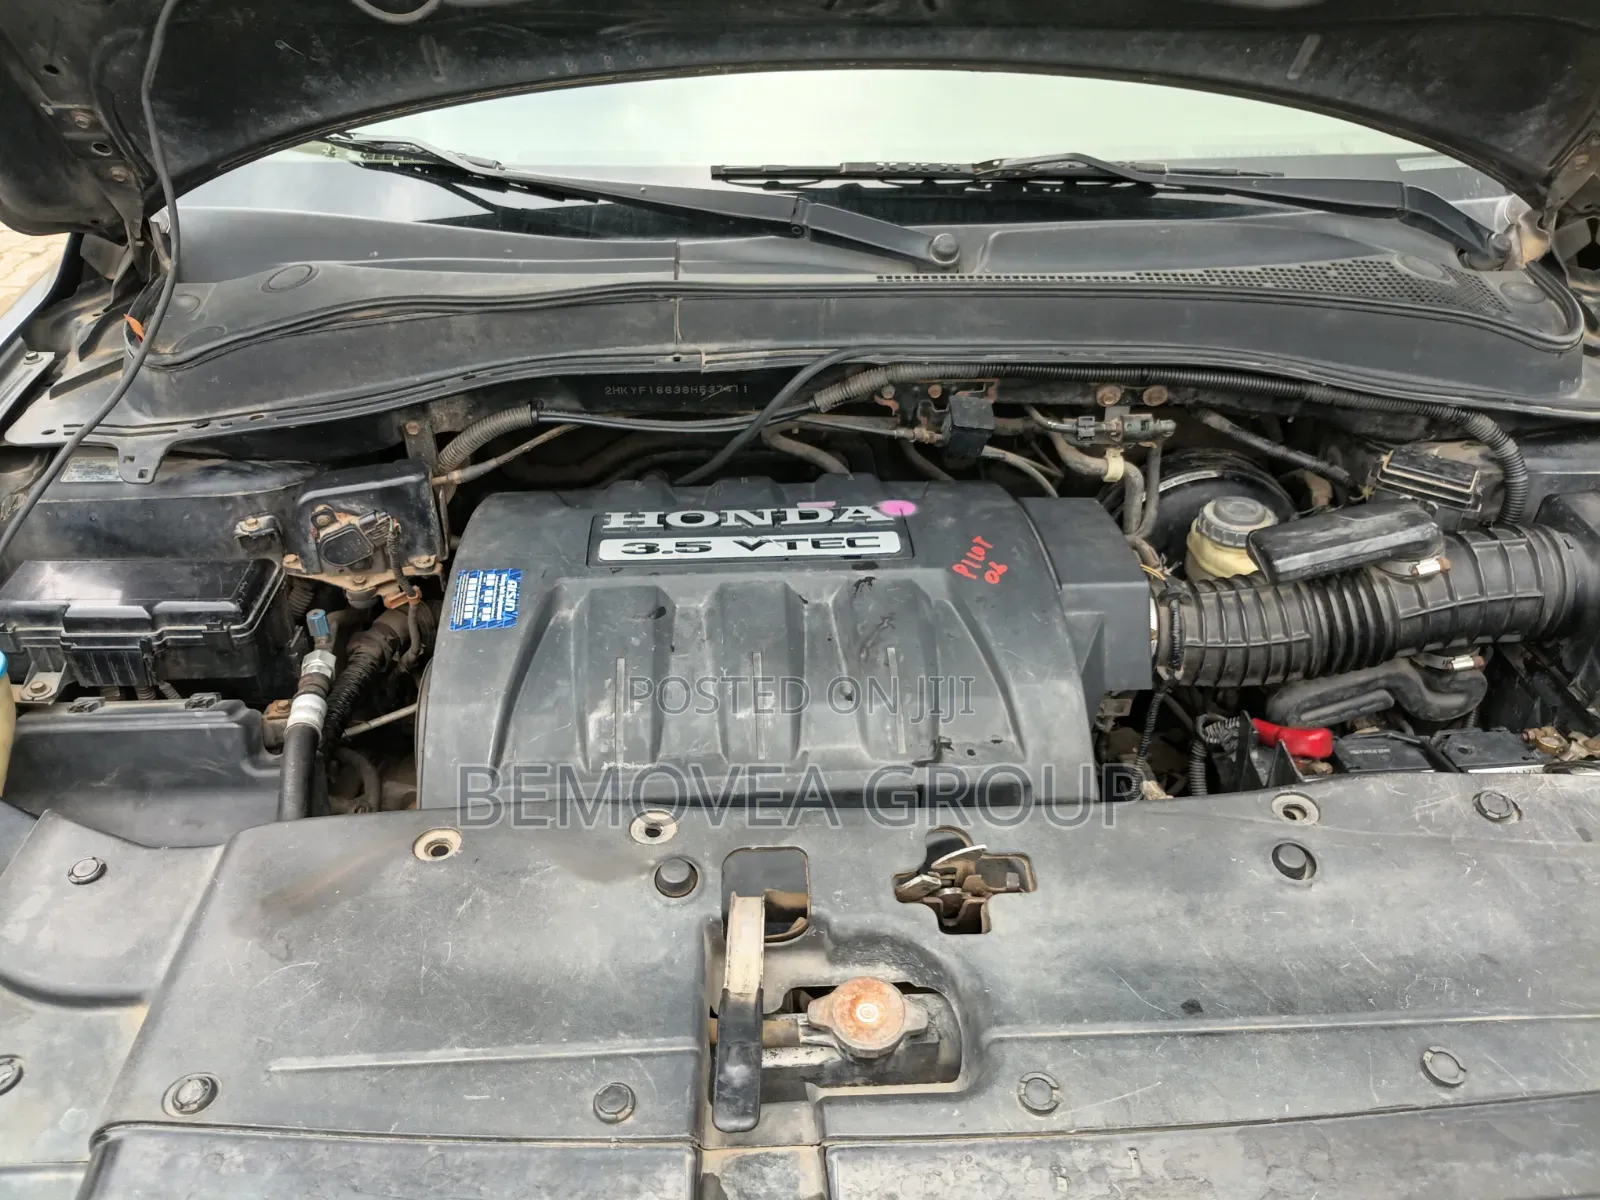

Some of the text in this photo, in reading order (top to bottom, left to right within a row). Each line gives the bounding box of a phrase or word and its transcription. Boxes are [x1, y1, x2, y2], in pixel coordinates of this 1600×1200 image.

[602, 506, 896, 533] HONDA
[621, 536, 882, 556] 3.5 VTEC
[952, 535, 994, 580] PILOT
[504, 579, 518, 612] AISIN
